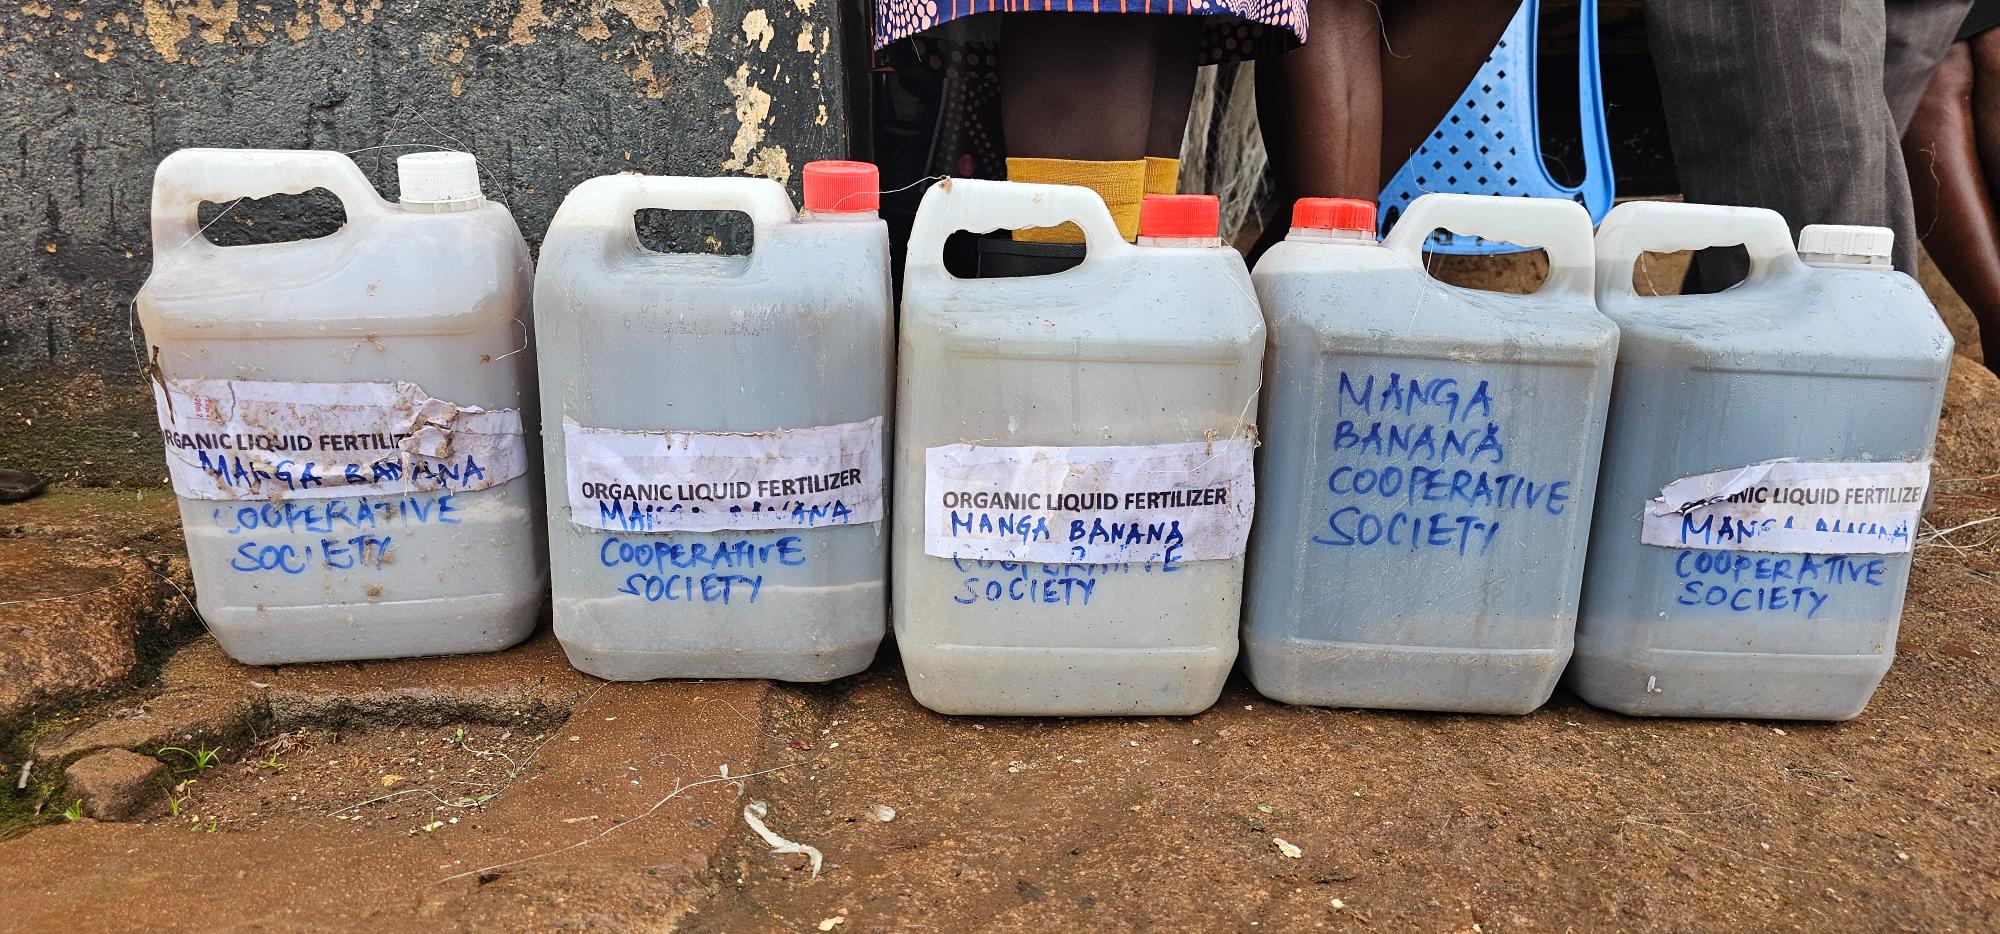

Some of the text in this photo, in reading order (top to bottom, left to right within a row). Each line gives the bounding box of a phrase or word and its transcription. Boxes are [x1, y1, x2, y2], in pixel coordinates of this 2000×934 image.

[1338, 371, 1492, 424] MANGA
[237, 434, 312, 452] LIQUID
[320, 432, 412, 451] FERTILIZ
[1333, 420, 1504, 464] BANANA
[582, 468, 862, 502] ORGANIC LIQUID FERTILIZER
[942, 487, 1227, 513] ORGANIC LIQUID FERTILIZER
[1328, 465, 1571, 516] COOPERATIVE
[1773, 487, 1840, 506] LIQUID
[1845, 485, 1922, 505] FERTILIZE
[950, 510, 1184, 545] MANGA BANANA
[1312, 506, 1500, 557] SOCIETY
[231, 535, 392, 574] SOCIETY
[600, 536, 806, 574] COOPERATIVE
[1675, 550, 1885, 587] COOPERATIVE
[617, 573, 763, 605] SOCIETY
[953, 577, 1096, 605] SOCIETY
[1678, 580, 1829, 619] SOCIETY
